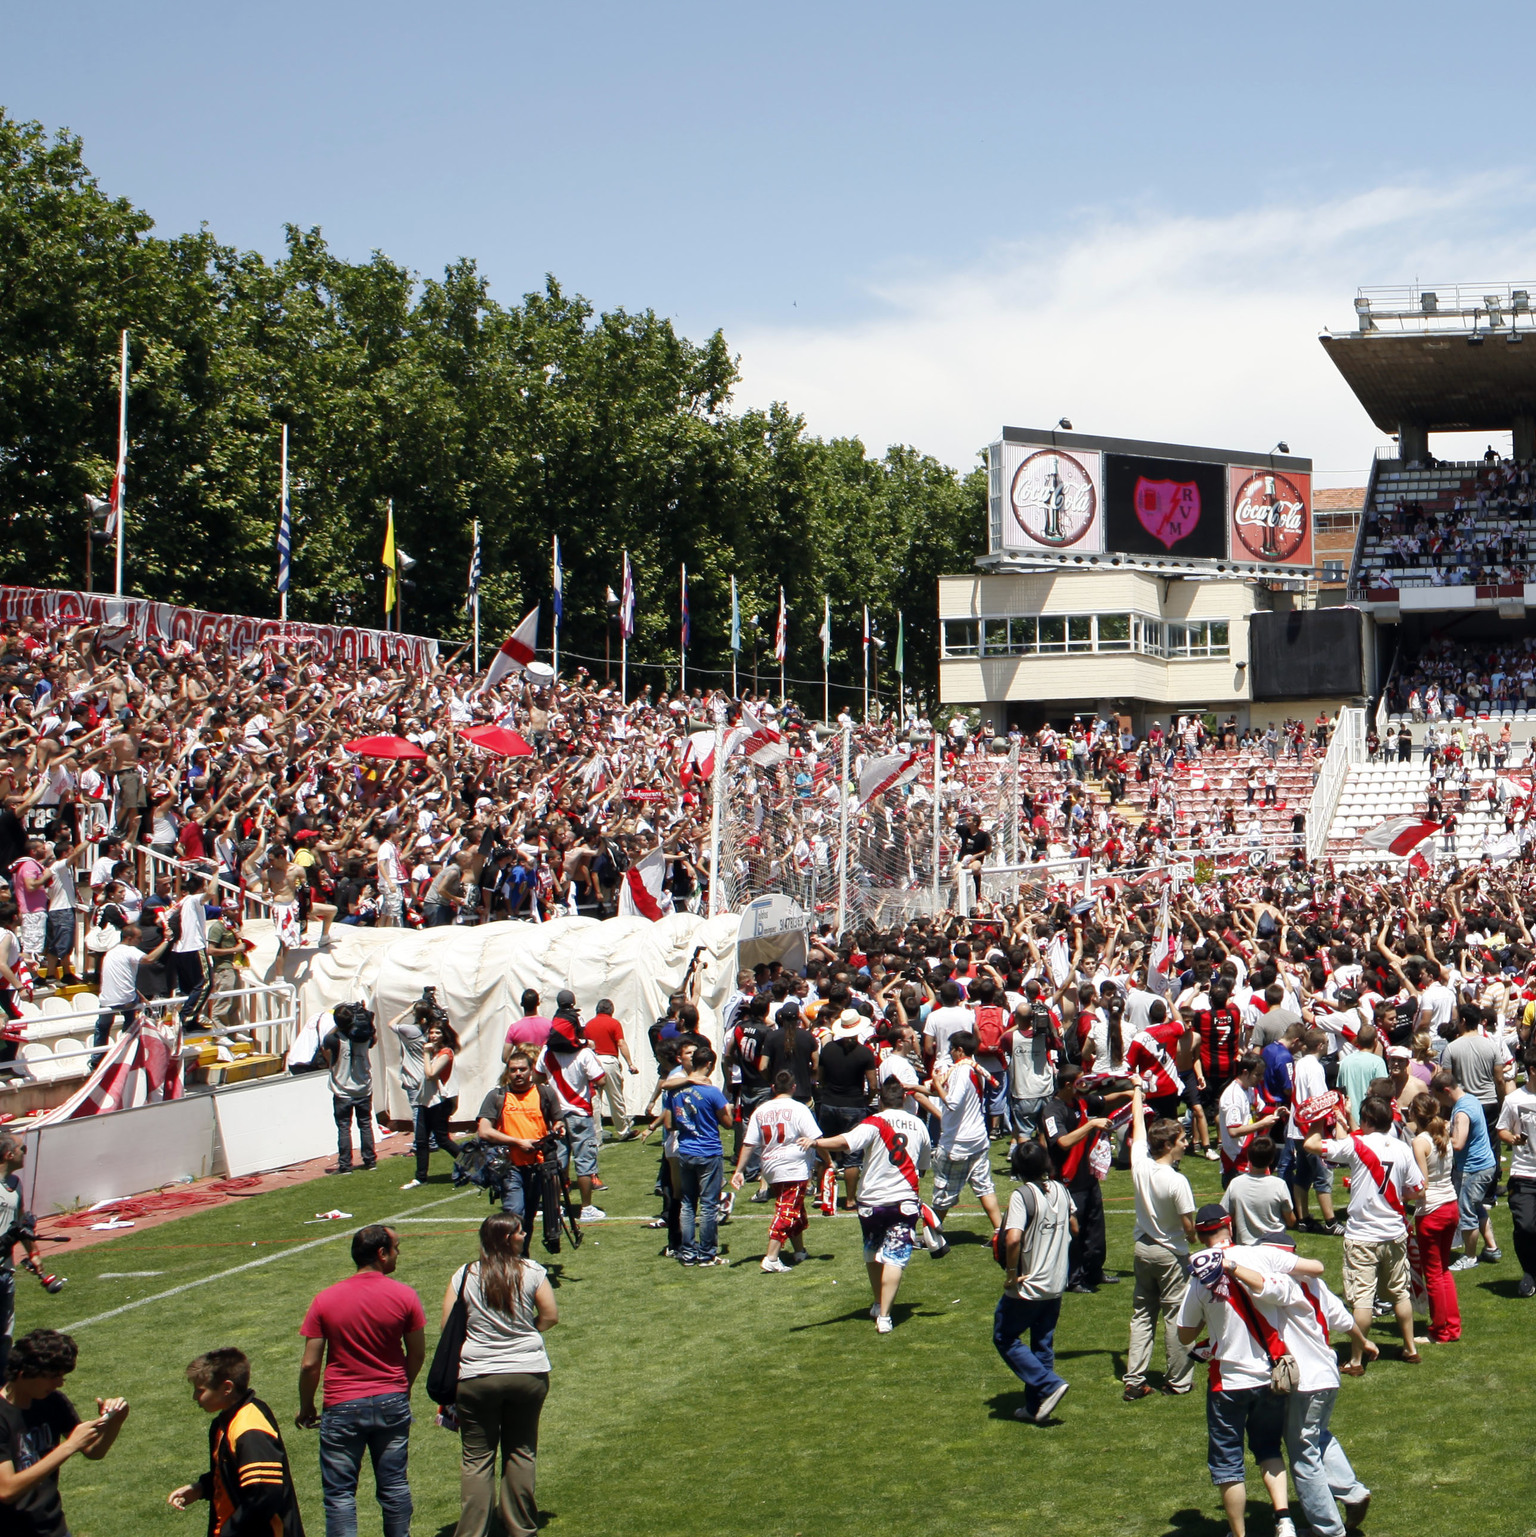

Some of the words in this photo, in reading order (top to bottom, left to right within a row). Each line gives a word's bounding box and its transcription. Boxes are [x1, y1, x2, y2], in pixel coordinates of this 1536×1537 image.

[1216, 1025, 1232, 1045] 7
[740, 1037, 757, 1062] 10
[760, 1122, 786, 1145] 11
[889, 1133, 908, 1167] 8
[1378, 1161, 1394, 1195] 7
